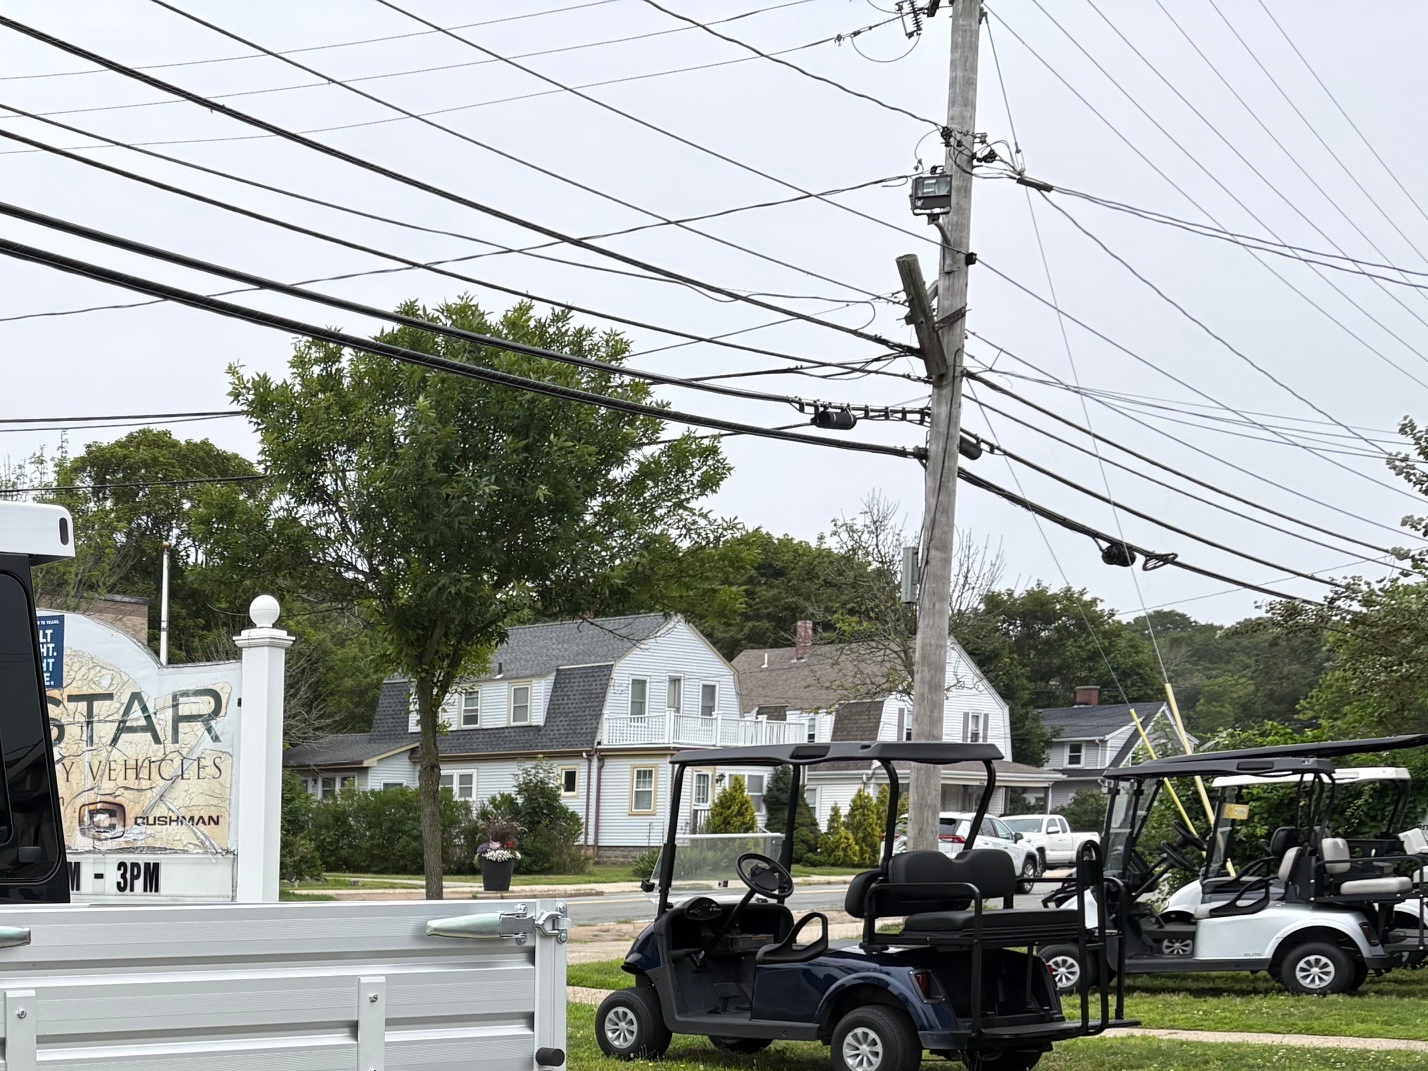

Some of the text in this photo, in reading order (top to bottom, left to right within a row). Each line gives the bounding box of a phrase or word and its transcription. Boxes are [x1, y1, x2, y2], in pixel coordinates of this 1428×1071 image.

[88, 756, 222, 781] VEHICLES
[134, 815, 220, 826] CUSHMAN
[116, 861, 160, 892] 3PM
